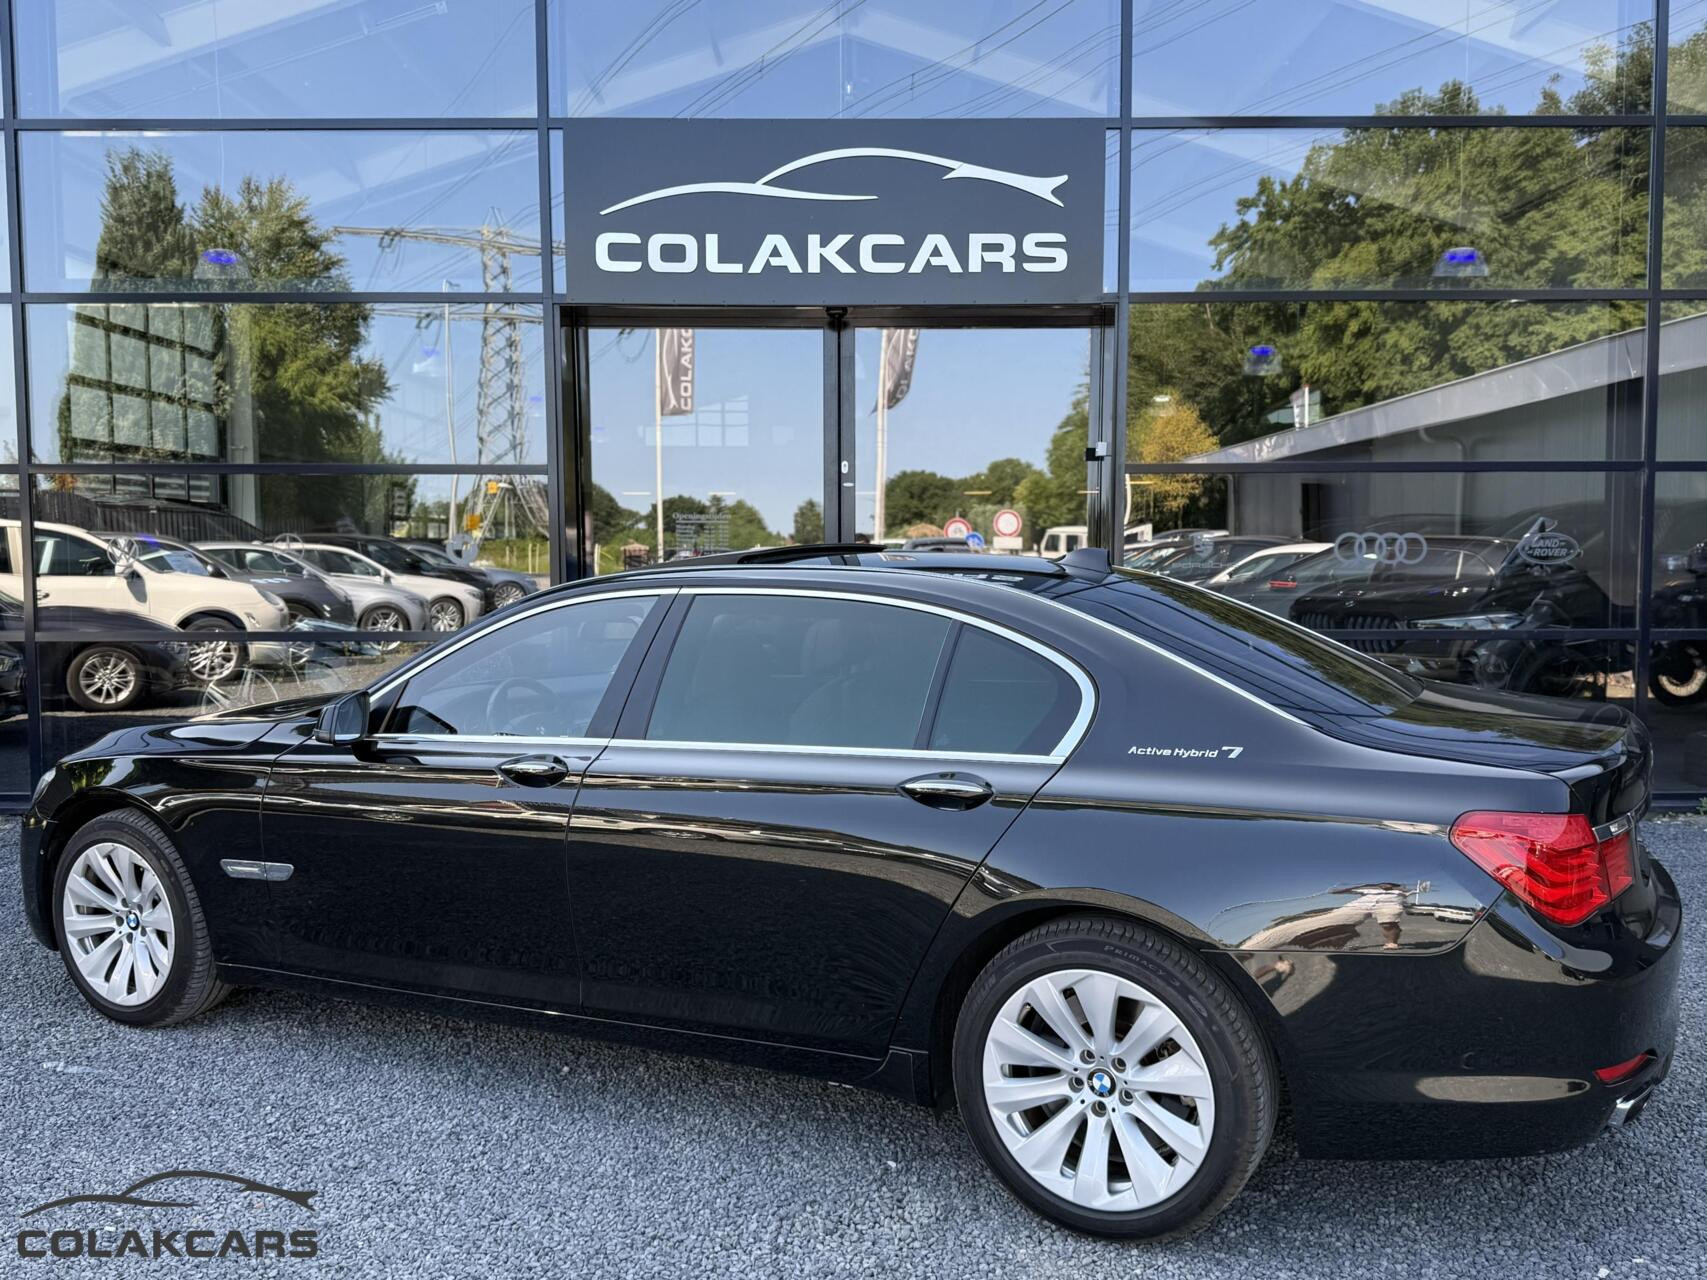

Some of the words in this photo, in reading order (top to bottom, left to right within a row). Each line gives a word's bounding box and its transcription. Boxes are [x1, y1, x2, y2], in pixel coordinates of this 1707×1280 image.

[595, 232, 1069, 274] COLAKCARS
[1533, 548, 1568, 557] ROVER
[1128, 746, 1171, 756] Active
[1174, 747, 1218, 758] Hybrid
[1221, 746, 1243, 759] 7
[1104, 945, 1167, 976] PRIMACY
